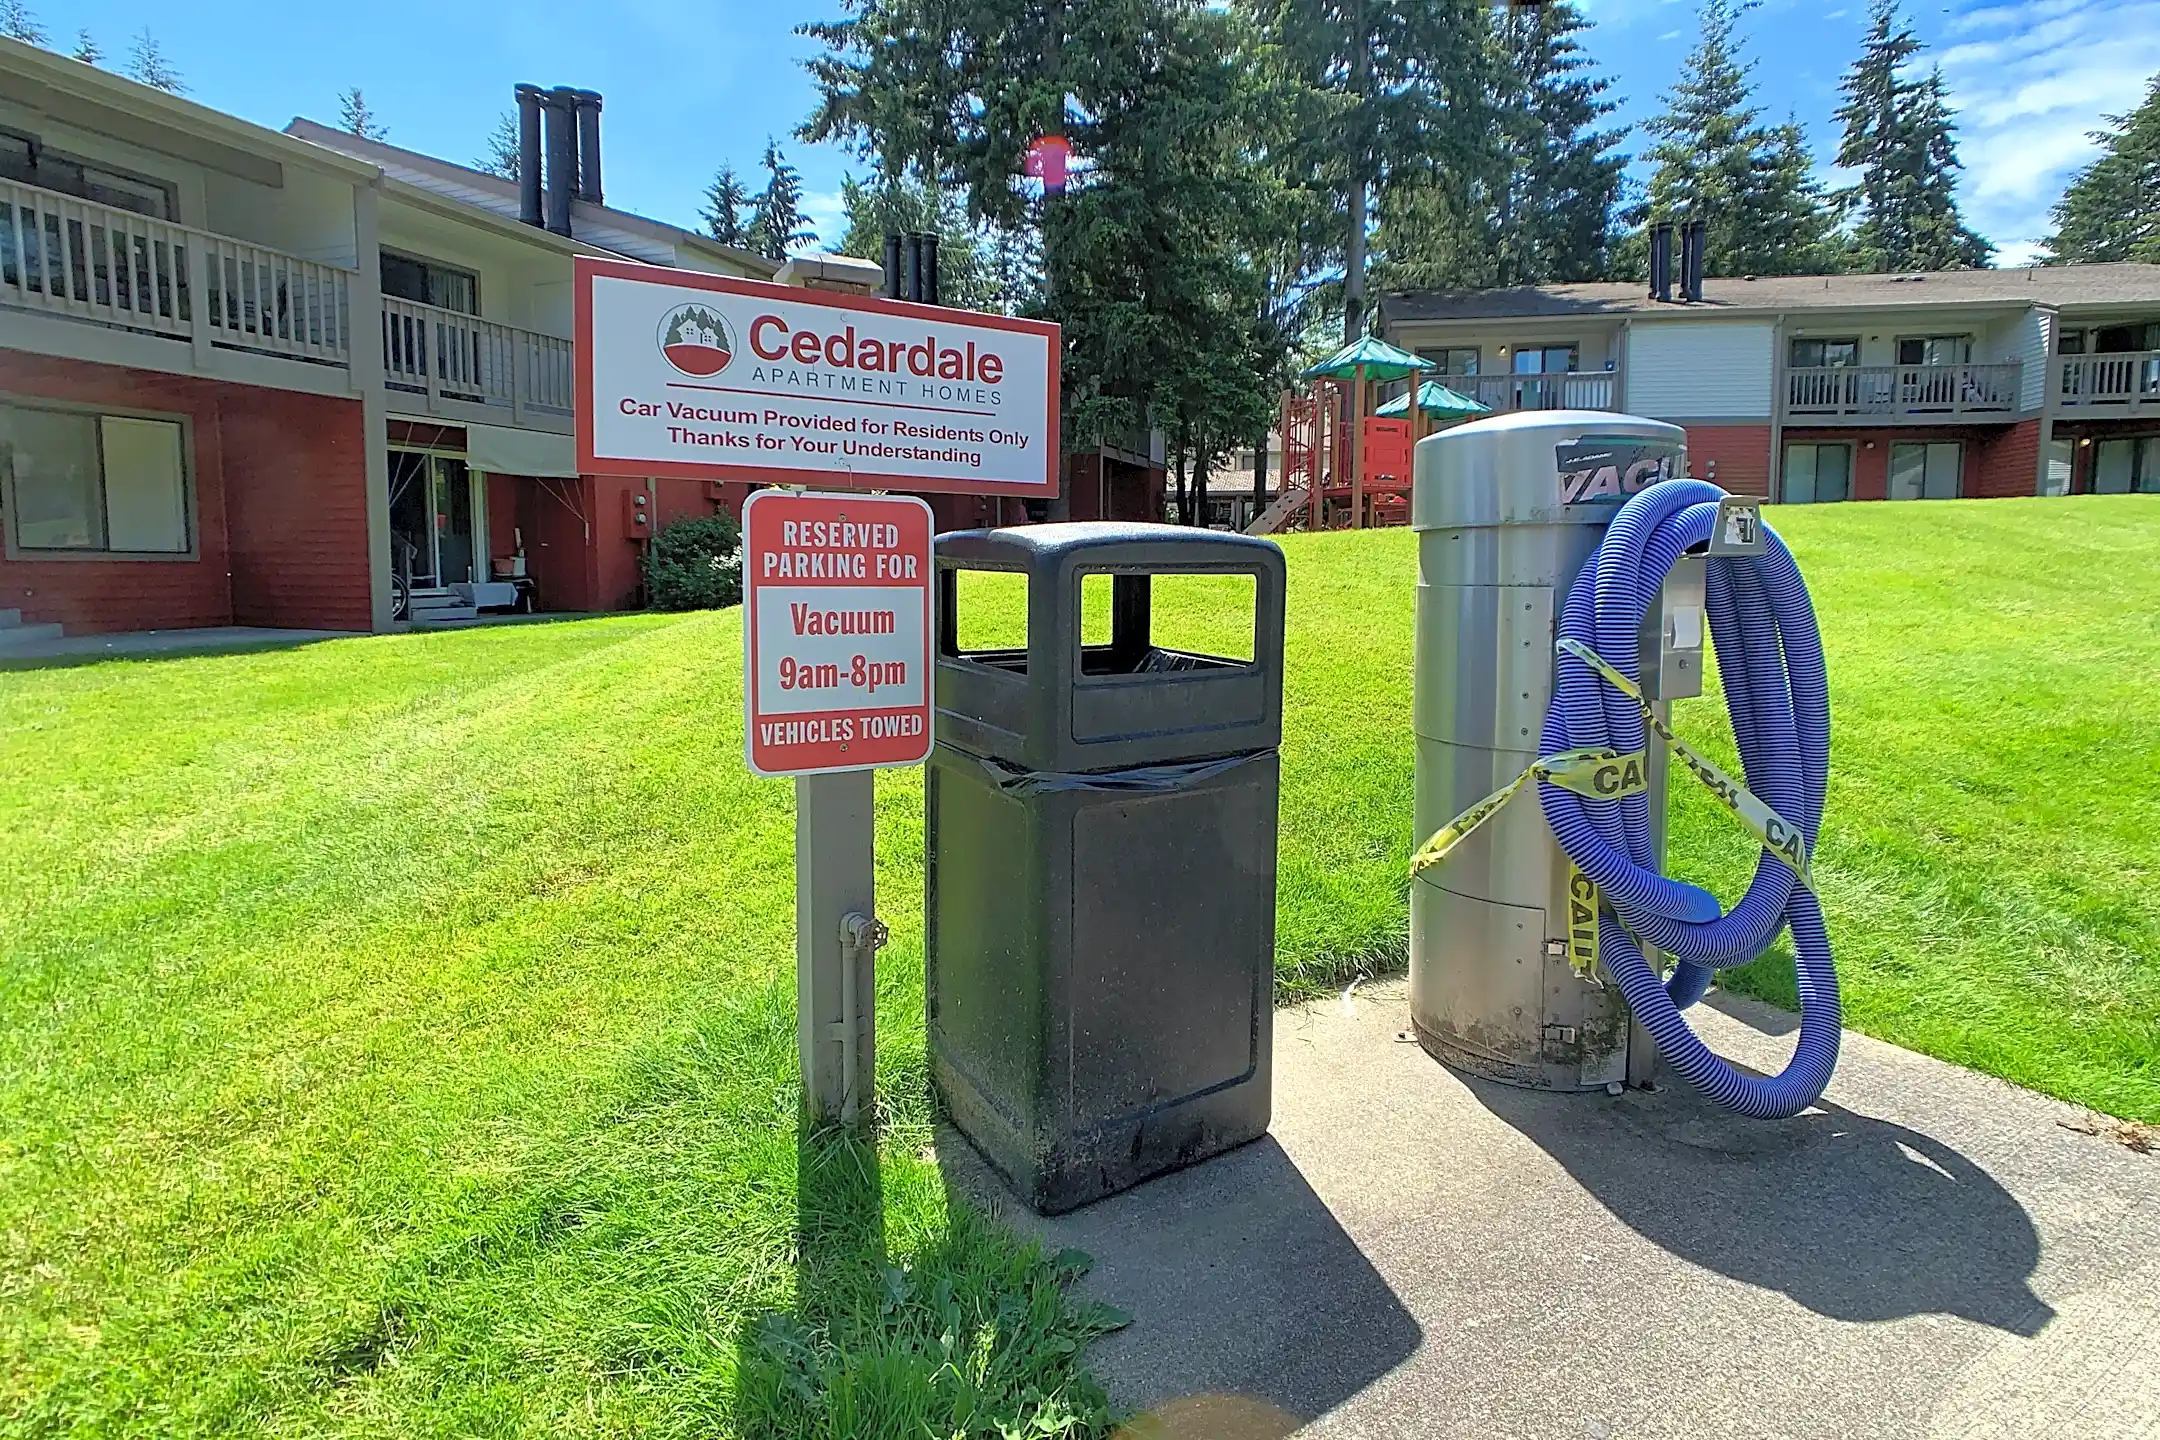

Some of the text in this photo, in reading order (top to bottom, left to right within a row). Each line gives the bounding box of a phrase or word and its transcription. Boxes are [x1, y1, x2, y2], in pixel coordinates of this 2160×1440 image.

[749, 315, 1004, 384] Cedardale
[752, 366, 1002, 405] APARTMENT HOMES
[619, 398, 1029, 449] Car Vacuum Provided for Residents Only
[667, 427, 981, 467] Thanks for Your Understanding
[783, 520, 899, 549] RESERVED
[764, 552, 917, 579] PARKING FOR
[790, 603, 895, 636] Vacuum
[779, 655, 906, 693] 9am-8pm
[760, 714, 923, 747] VEHICLES TOWED
[1593, 756, 1648, 795] CA
